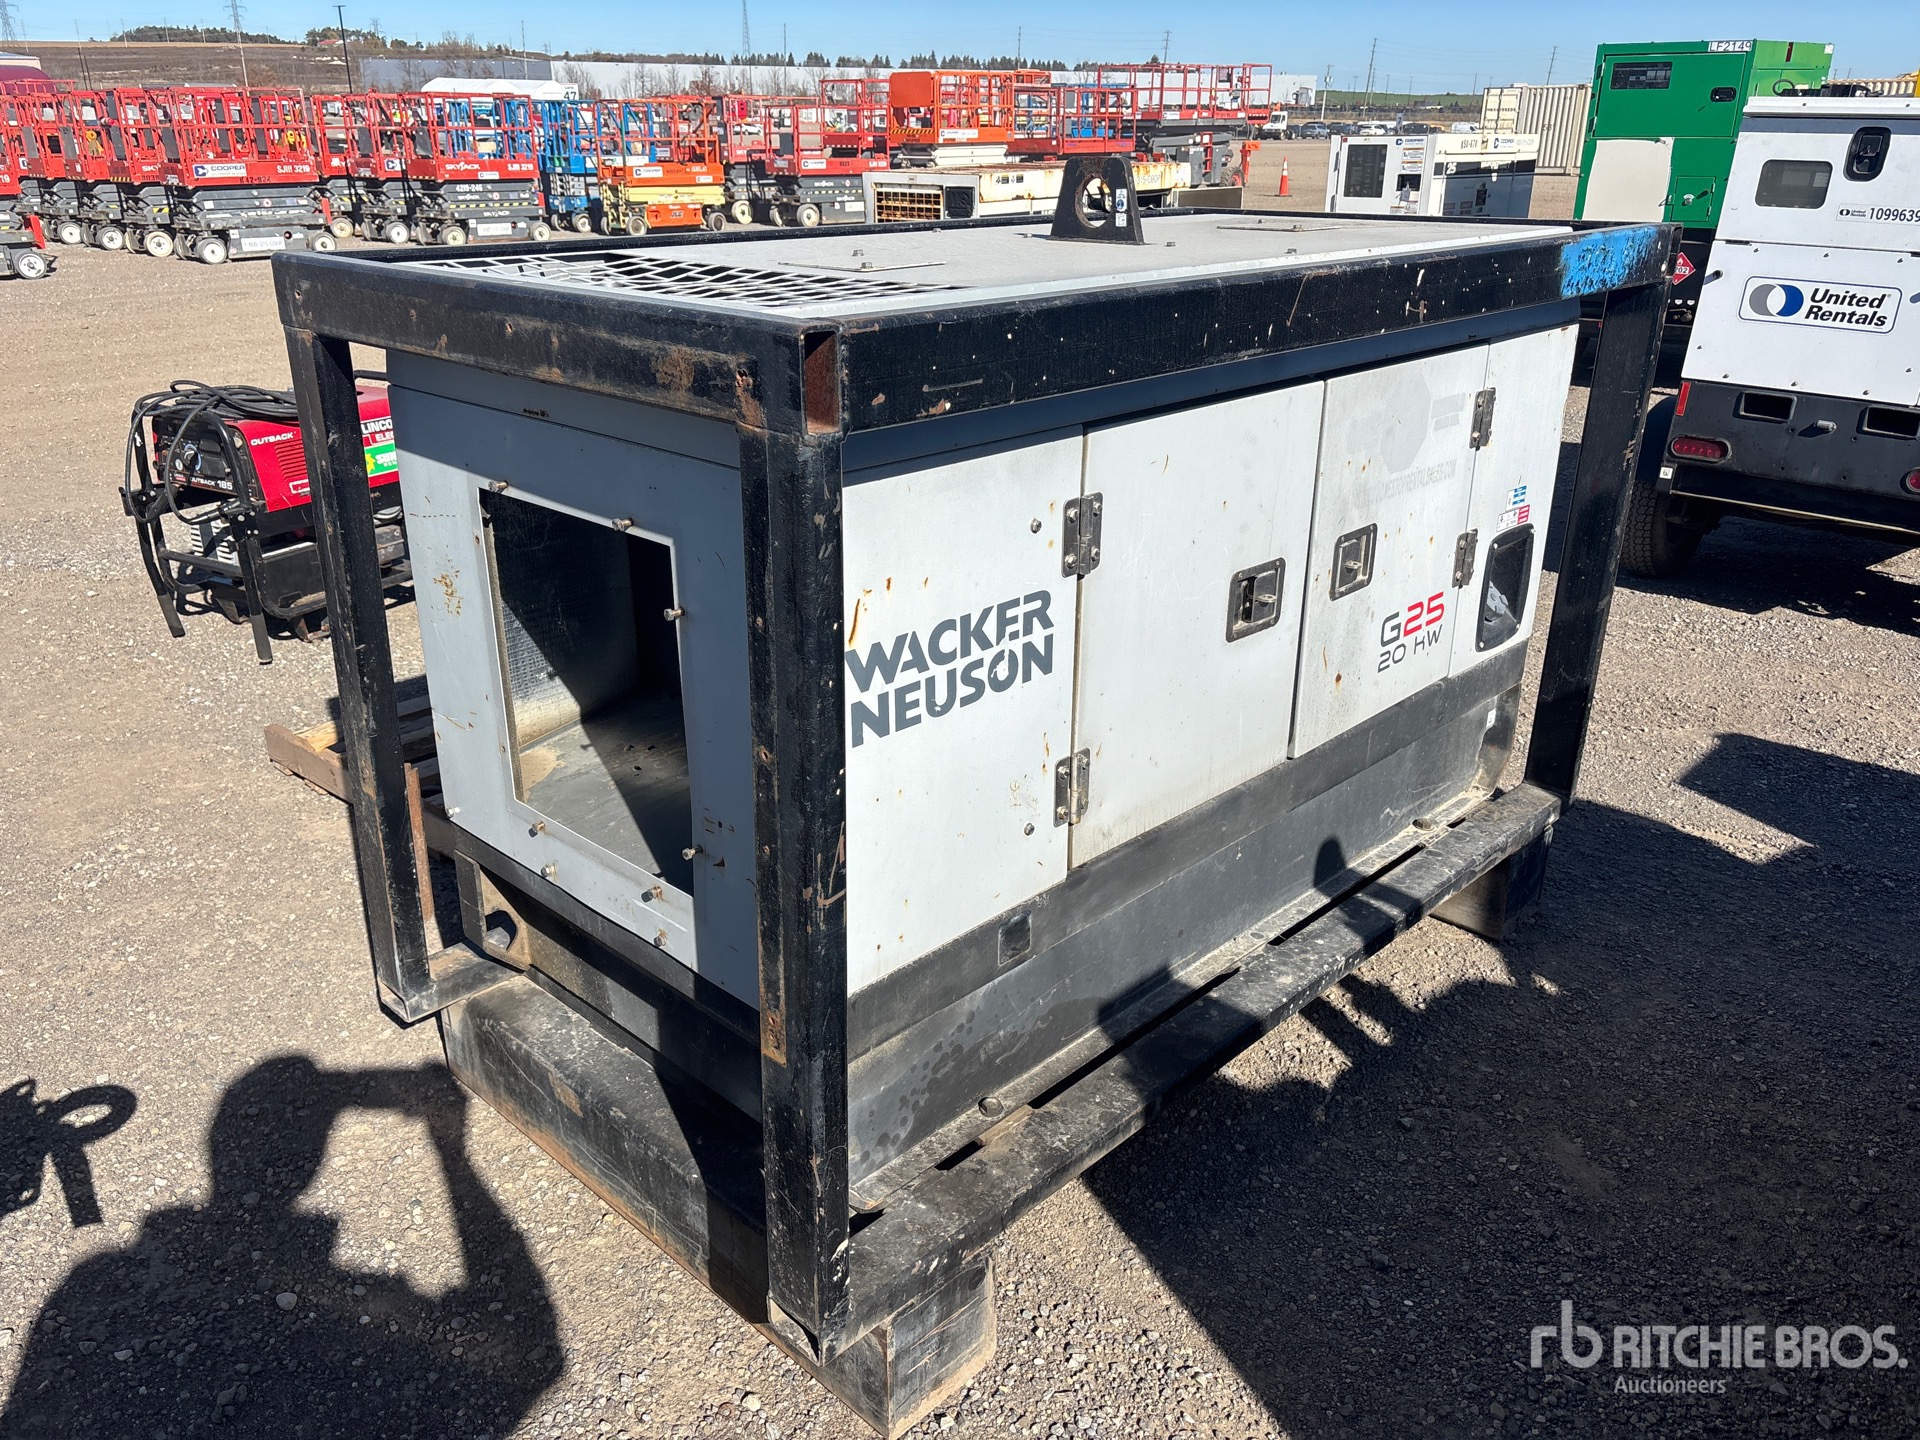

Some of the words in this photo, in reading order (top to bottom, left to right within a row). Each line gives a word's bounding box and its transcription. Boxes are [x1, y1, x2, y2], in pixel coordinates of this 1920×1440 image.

[1709, 41, 1752, 52] LF2149
[564, 91, 577, 100] 47
[445, 162, 480, 171] SKYJACK
[1446, 162, 1457, 174] 25
[0, 174, 10, 184] 19
[1869, 208, 1920, 223] 1099639
[1810, 288, 1887, 309] United
[1804, 305, 1888, 327] Rentals
[250, 433, 294, 446] OUTBACK
[189, 477, 216, 487] OUTBACK
[216, 480, 233, 490] 185
[1380, 591, 1445, 648] G25
[844, 589, 1055, 694] WACKER
[1377, 643, 1407, 674] 20
[850, 632, 1054, 749] NEUSON
